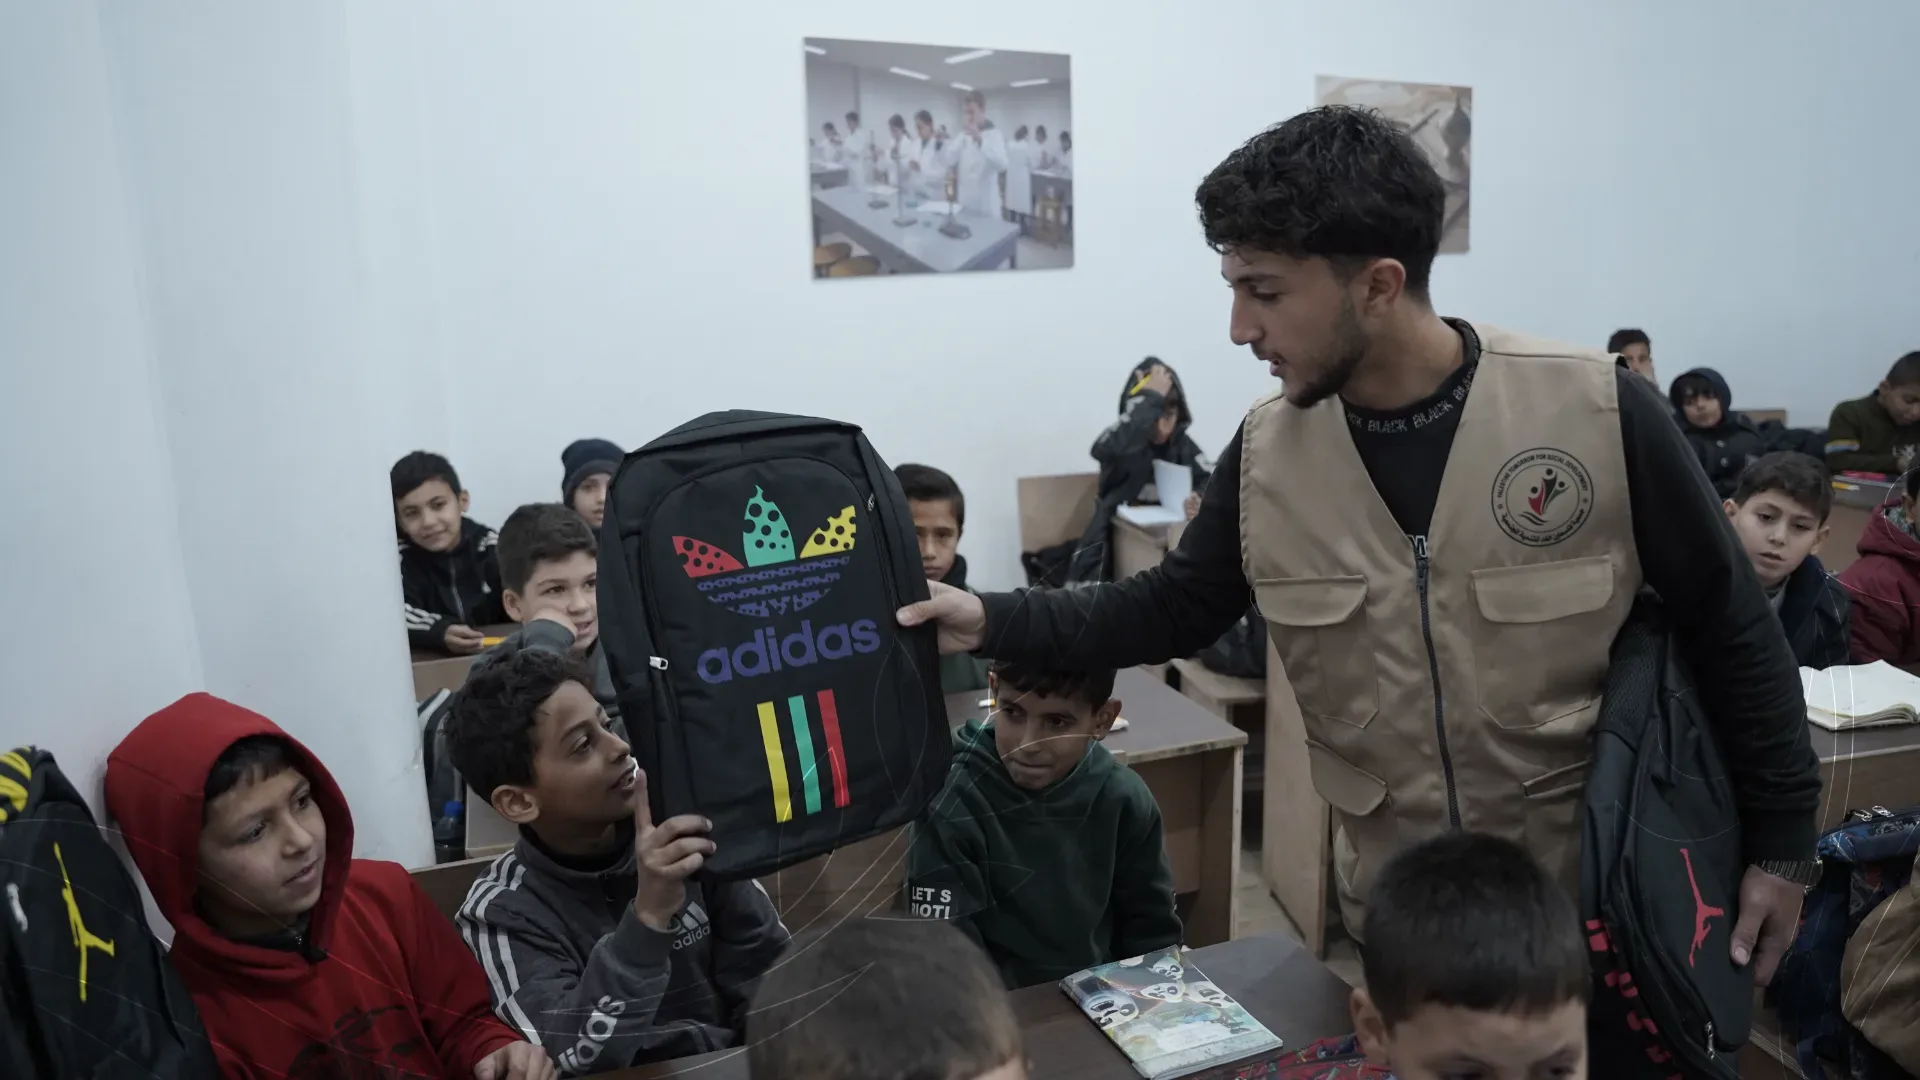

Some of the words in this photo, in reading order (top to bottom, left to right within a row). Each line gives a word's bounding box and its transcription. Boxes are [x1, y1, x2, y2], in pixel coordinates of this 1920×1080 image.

[1368, 418, 1408, 434] BLACK
[1412, 398, 1454, 429] BLACK
[1497, 473, 1511, 498] PALESTINE
[1508, 454, 1535, 474] TOMORROW
[1536, 453, 1546, 461] FOR
[1547, 454, 1564, 465] SOCIAL
[1564, 460, 1588, 492] DEVELOPMENT
[697, 619, 881, 685] adidas
[911, 902, 951, 920] RIOT!
